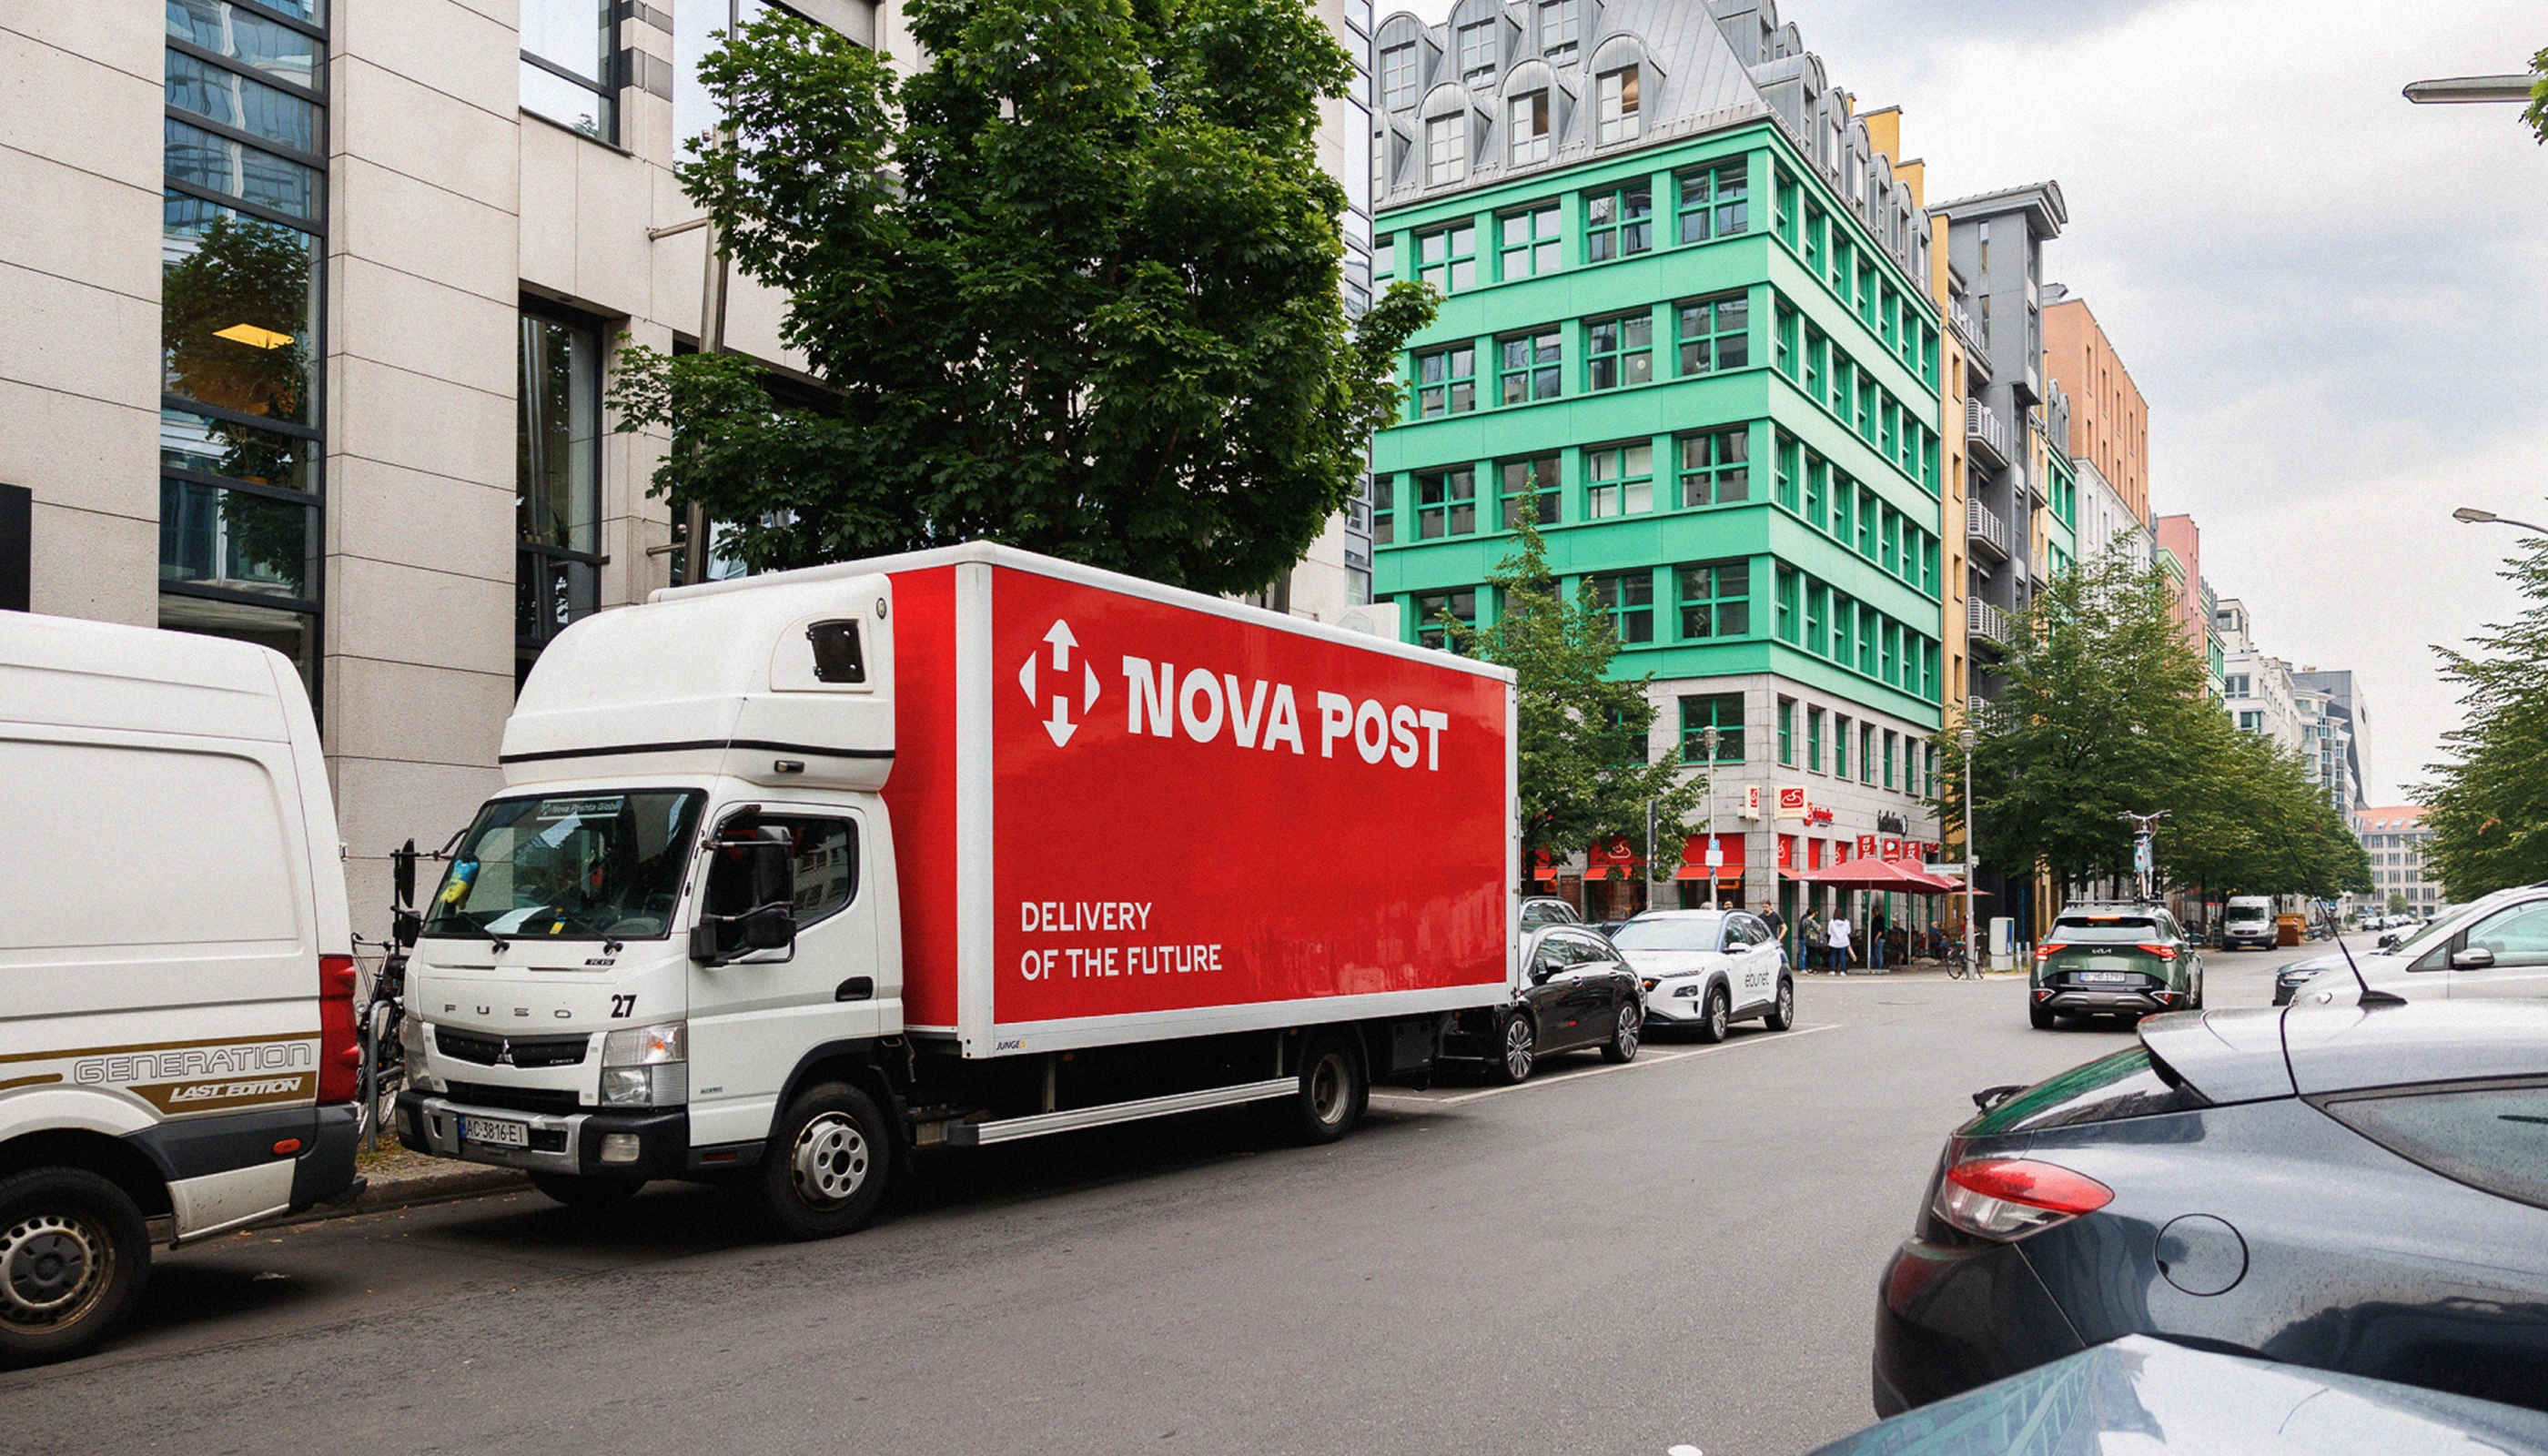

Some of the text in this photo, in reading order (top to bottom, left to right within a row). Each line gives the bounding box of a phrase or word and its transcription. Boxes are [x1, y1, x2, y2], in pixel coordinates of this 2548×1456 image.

[1122, 654, 1449, 772] NOVA POST
[1021, 901, 1152, 932] DELIVERY
[1020, 944, 1223, 981] OF THE FUTURE
[445, 1004, 571, 1019] FUSO
[611, 994, 637, 1018] 27
[74, 1043, 310, 1085] GENERATION
[169, 1077, 303, 1102] LAST EDITION
